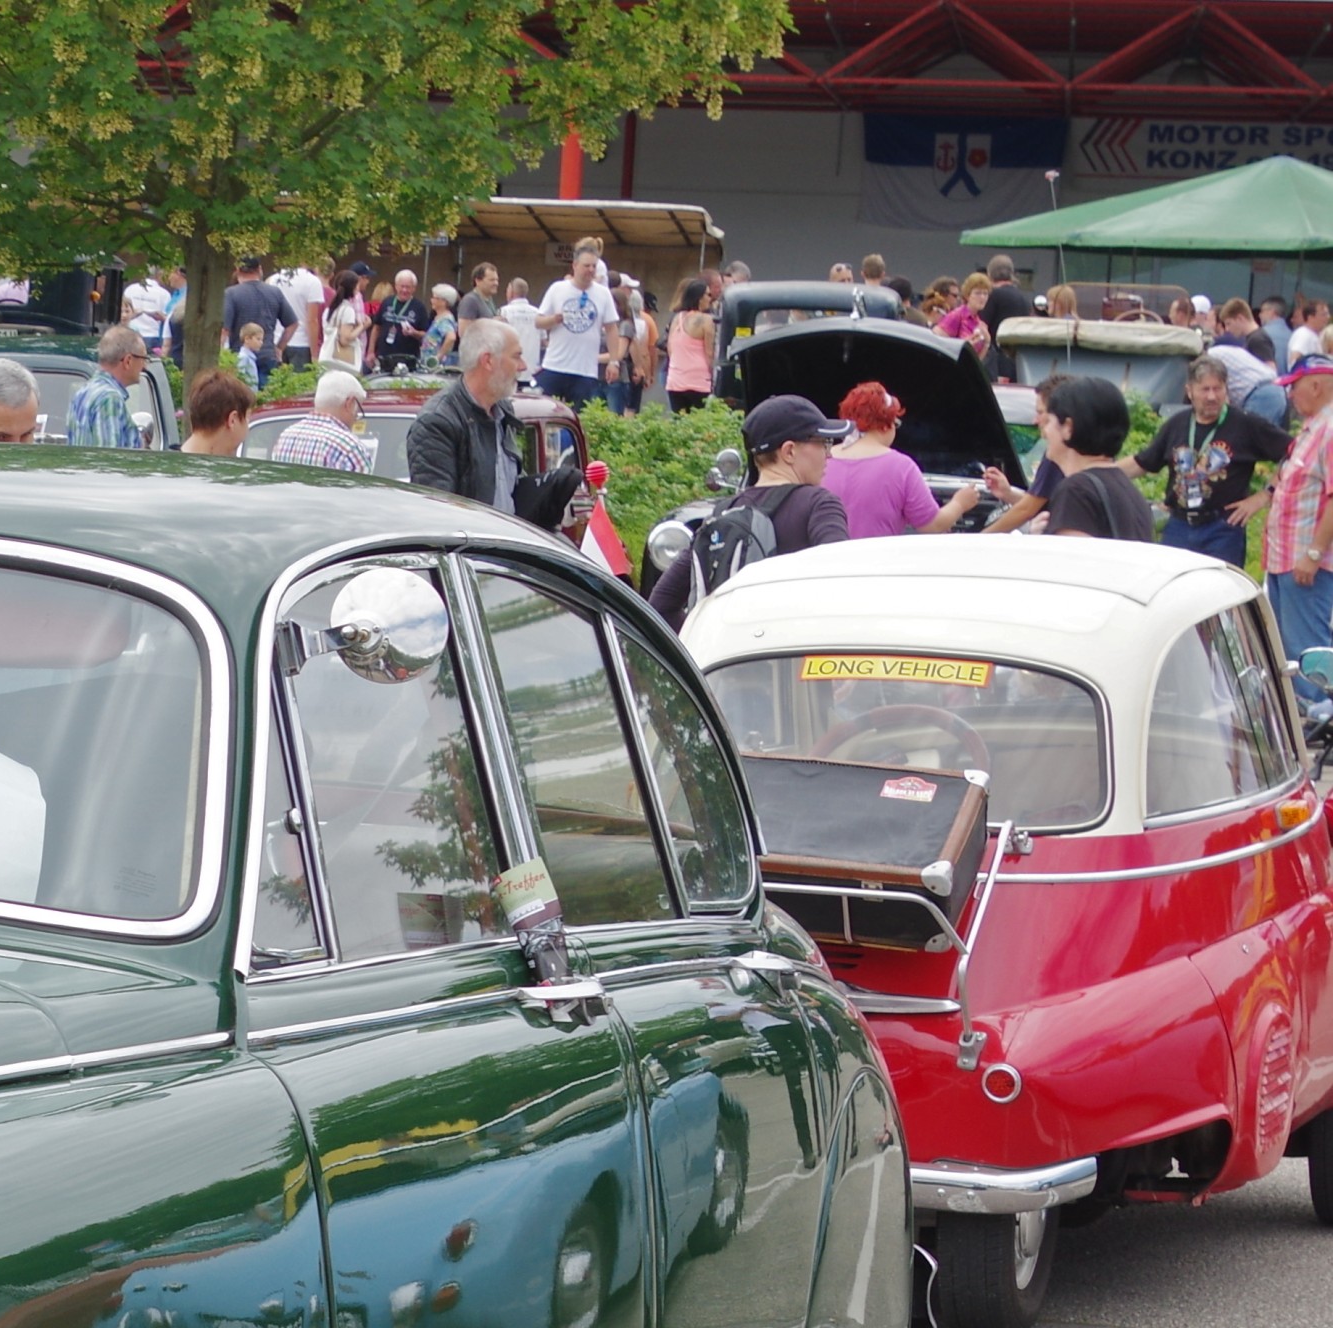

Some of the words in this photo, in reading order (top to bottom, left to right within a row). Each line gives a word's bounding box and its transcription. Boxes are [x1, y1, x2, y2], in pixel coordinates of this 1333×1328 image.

[1147, 124, 1269, 146] MOTOR
[1282, 126, 1333, 146] SP
[1146, 150, 1237, 169] KONZ
[806, 659, 874, 675] LONG
[882, 660, 984, 682] VEHICLE
